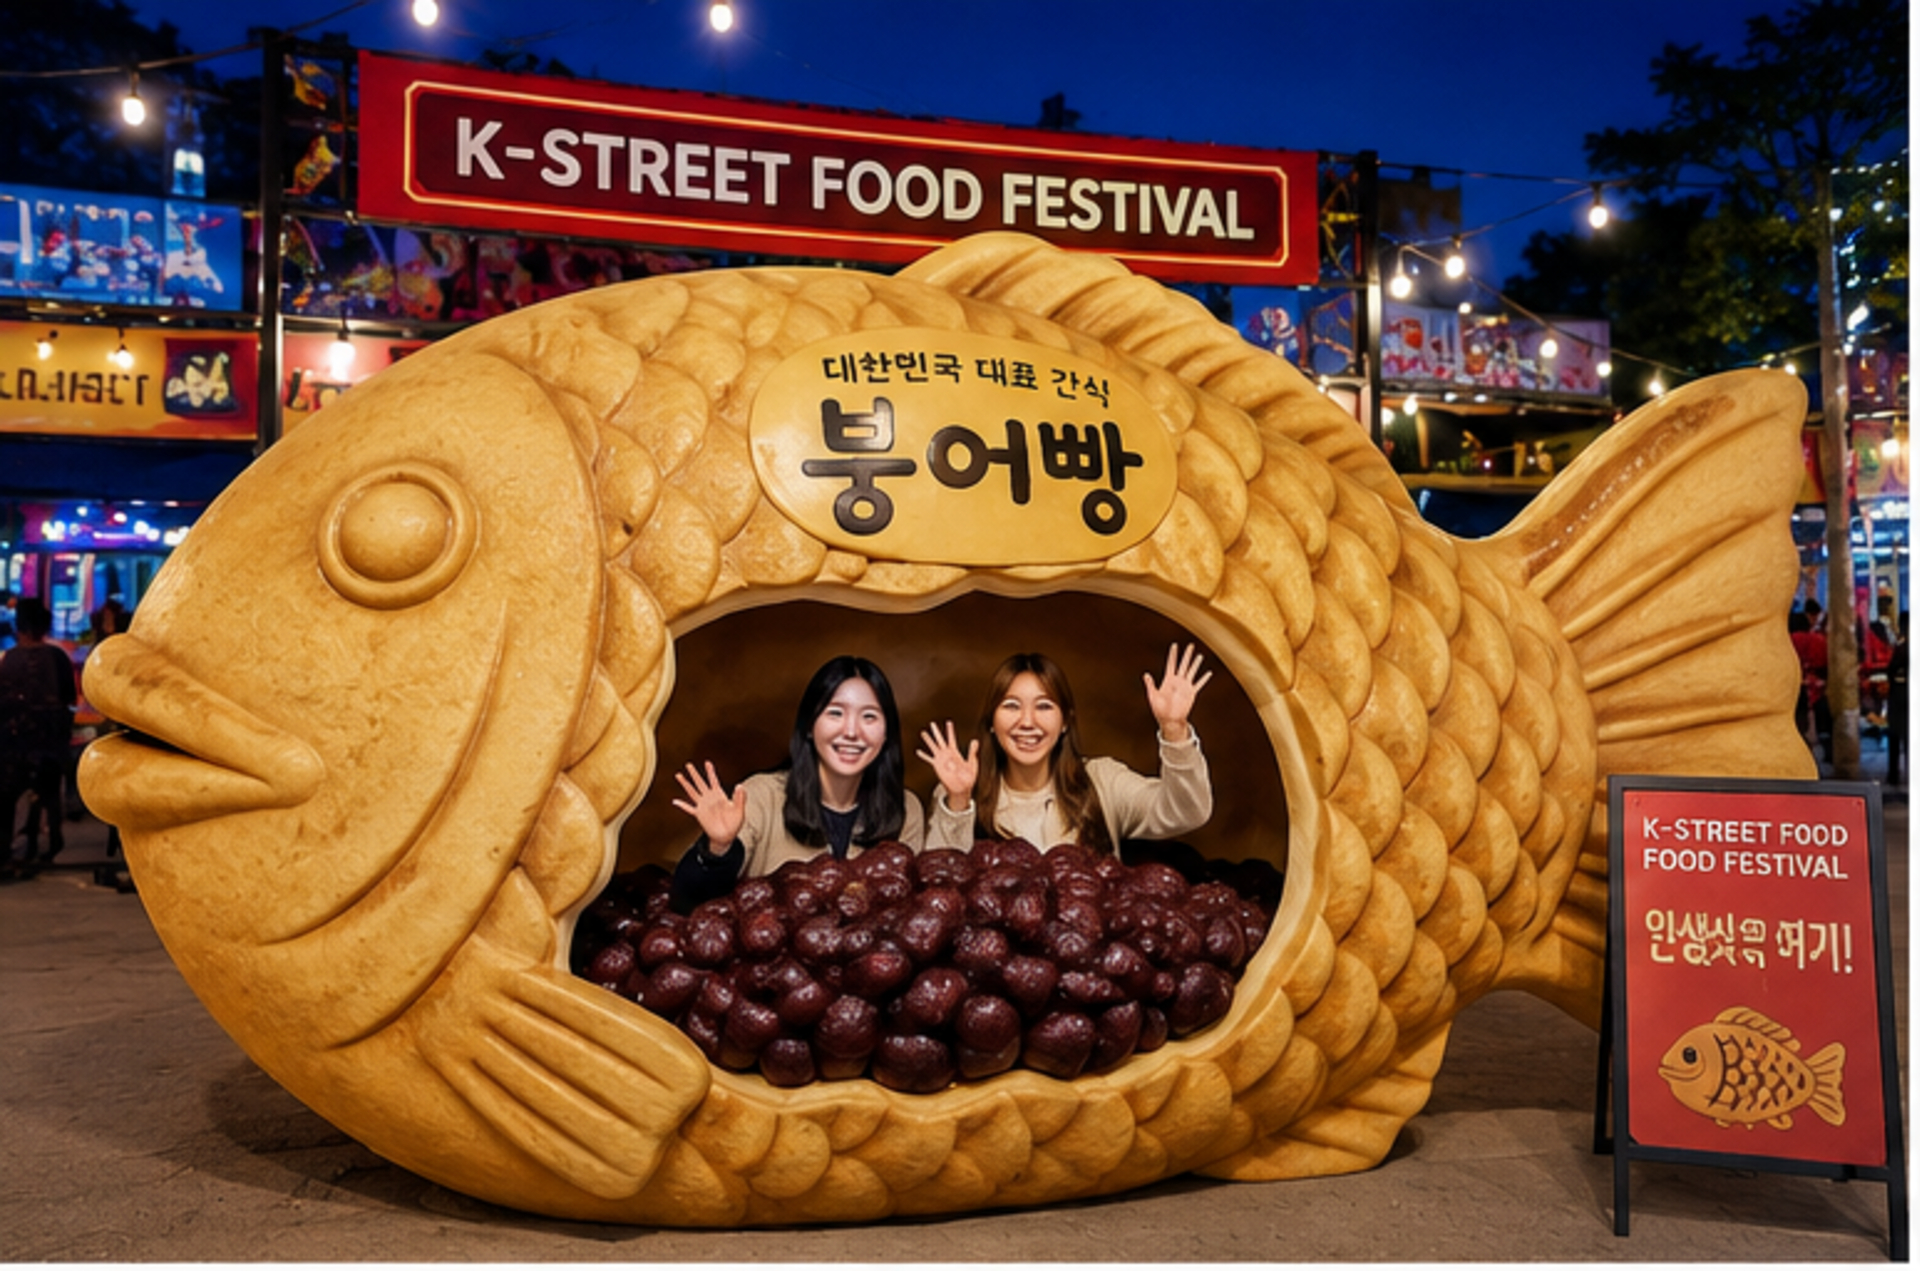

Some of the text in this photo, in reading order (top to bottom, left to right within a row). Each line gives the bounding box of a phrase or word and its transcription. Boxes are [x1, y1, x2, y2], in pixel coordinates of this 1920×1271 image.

[457, 117, 1255, 240] K-STREET FOOD FESTIVAL
[975, 358, 1038, 390] 대표
[1051, 368, 1110, 408] 간식
[801, 396, 1143, 536] 붕어빵
[1643, 817, 1848, 846] K-STREET FOOD
[1643, 848, 1849, 879] FOOD FESTIVAL
